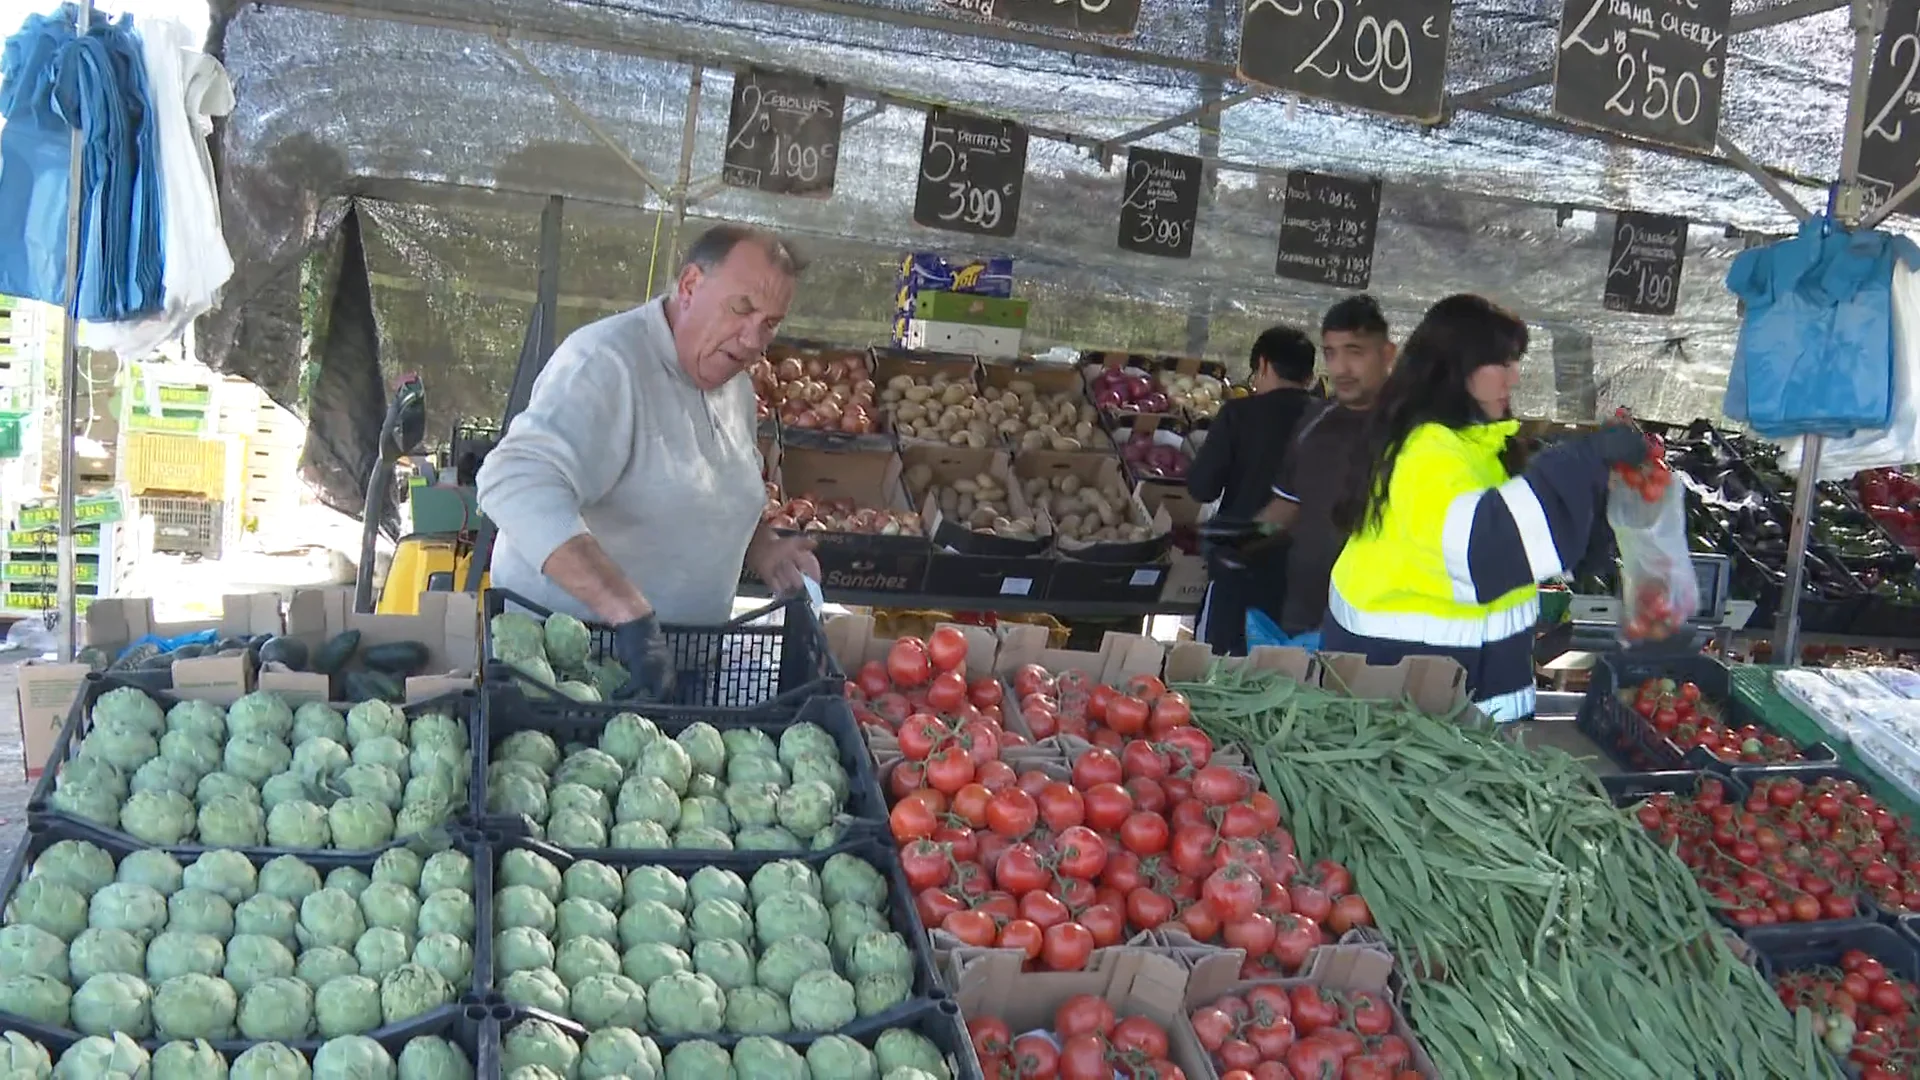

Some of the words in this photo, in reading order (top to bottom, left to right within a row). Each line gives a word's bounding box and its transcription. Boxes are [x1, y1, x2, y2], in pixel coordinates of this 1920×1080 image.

[1661, 12, 1723, 52] CHERRY
[957, 130, 1012, 153] PATATAS
[826, 569, 908, 589] Sanchez
